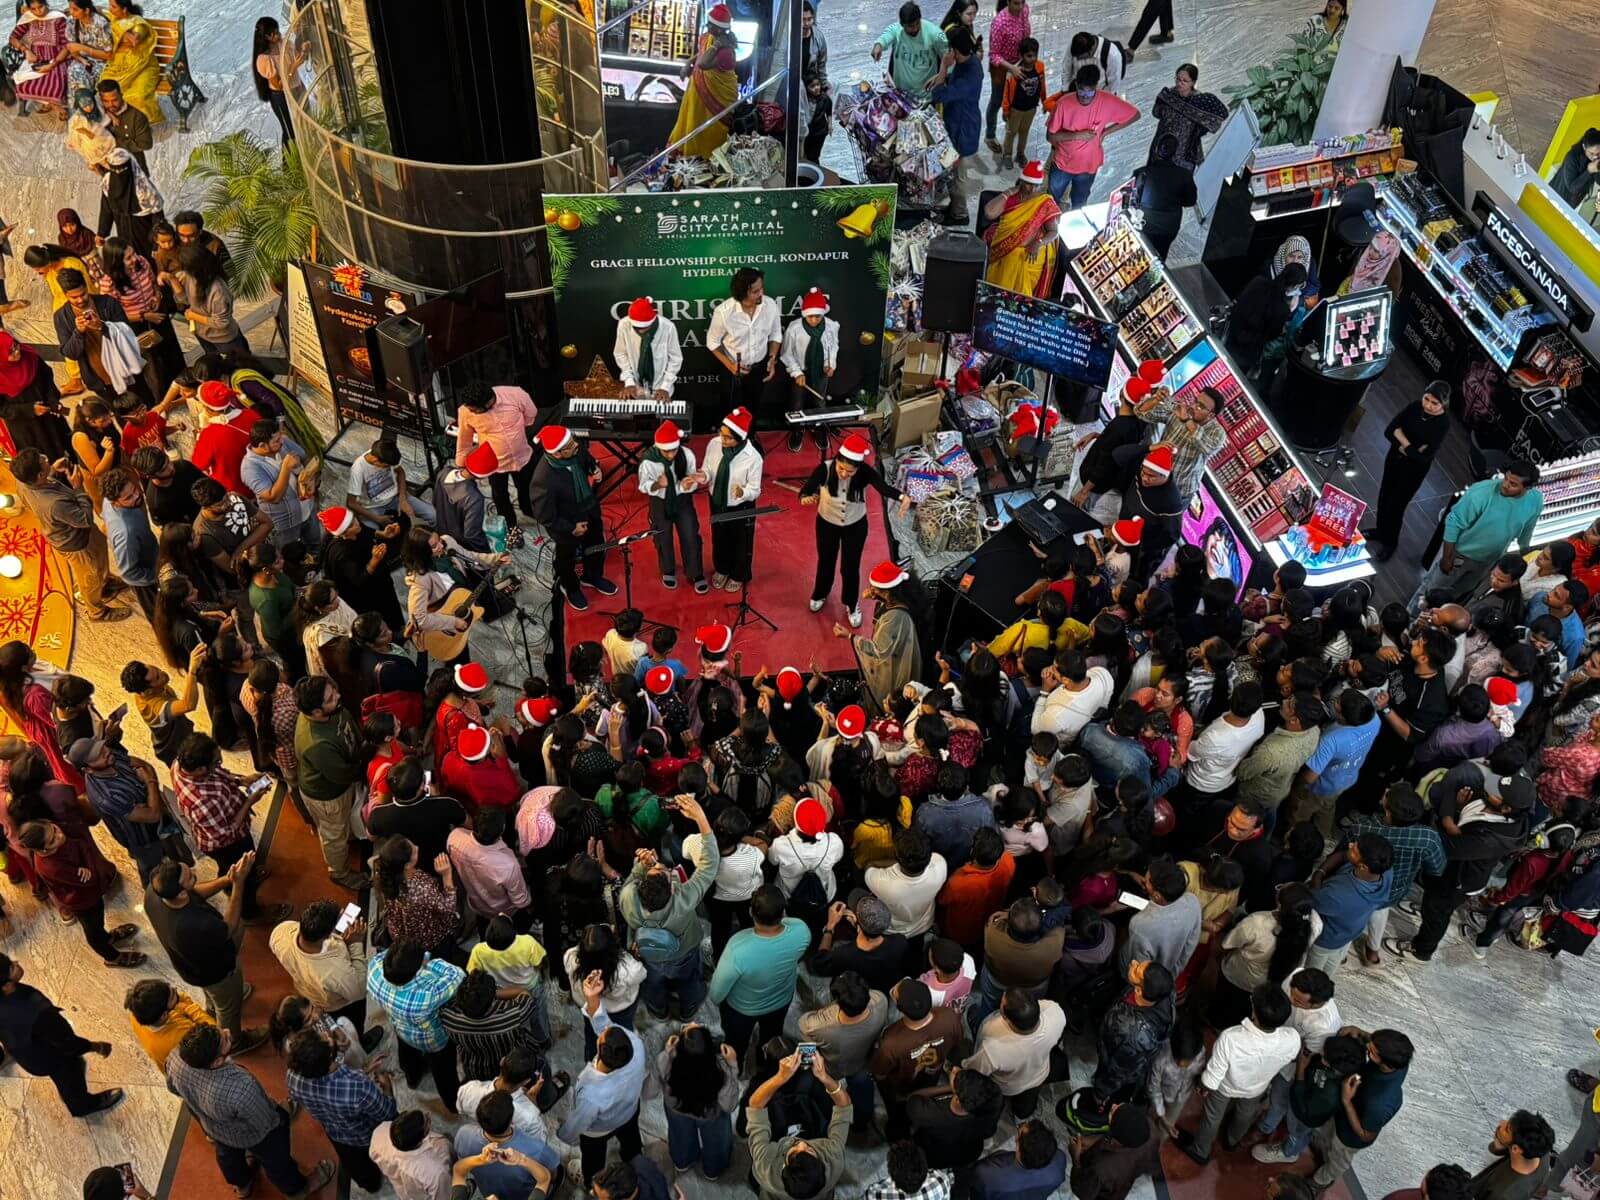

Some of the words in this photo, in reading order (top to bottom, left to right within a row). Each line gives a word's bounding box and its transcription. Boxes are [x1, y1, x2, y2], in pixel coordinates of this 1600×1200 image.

[680, 214, 739, 223] SARATH
[680, 224, 713, 232] CITY
[720, 222, 784, 231] CAPITAL
[590, 259, 634, 268] GRACE
[636, 256, 717, 267] FELLOWSHIP
[719, 254, 777, 264] CHURCH,
[779, 251, 849, 262] KONDAPUR
[1487, 212, 1567, 311] FACESCANADA
[995, 315, 1016, 326] (Jesus
[1016, 322, 1030, 331] has
[1031, 326, 1059, 340] forgiven
[1060, 336, 1073, 344] our
[1073, 340, 1091, 351] sins)
[1065, 329, 1076, 337] Ne
[992, 331, 1013, 342] (Jesus
[1013, 337, 1026, 346] has
[1027, 343, 1046, 353] given
[1056, 352, 1071, 360] new
[1061, 344, 1072, 352] Ne
[1320, 516, 1346, 534] FREE
